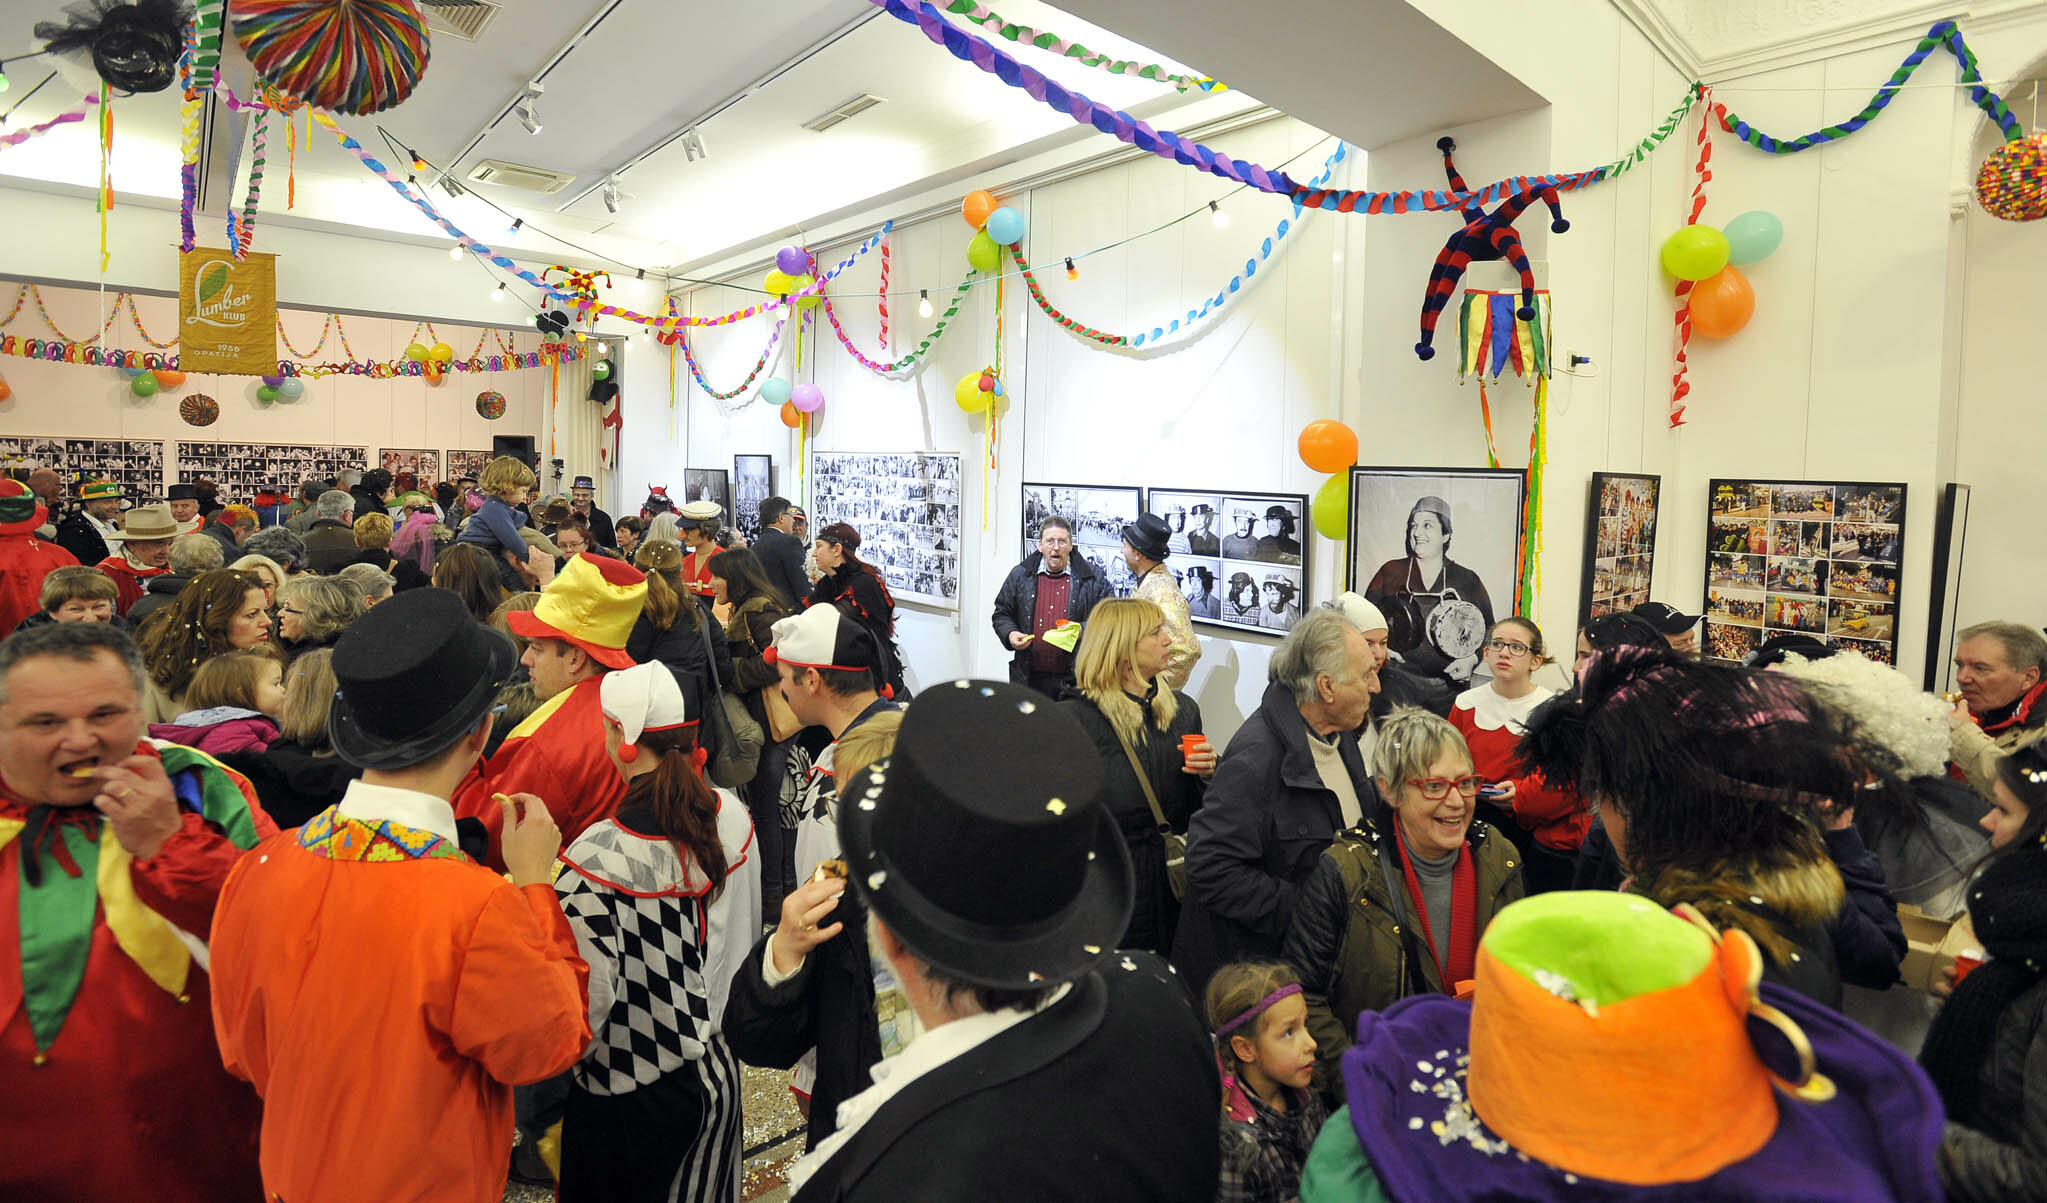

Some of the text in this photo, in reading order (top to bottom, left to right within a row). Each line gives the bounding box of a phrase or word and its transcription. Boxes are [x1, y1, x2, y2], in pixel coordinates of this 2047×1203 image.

[185, 260, 252, 328] Lumber
[223, 311, 246, 320] KLUB
[193, 350, 239, 359] OPATIJA
